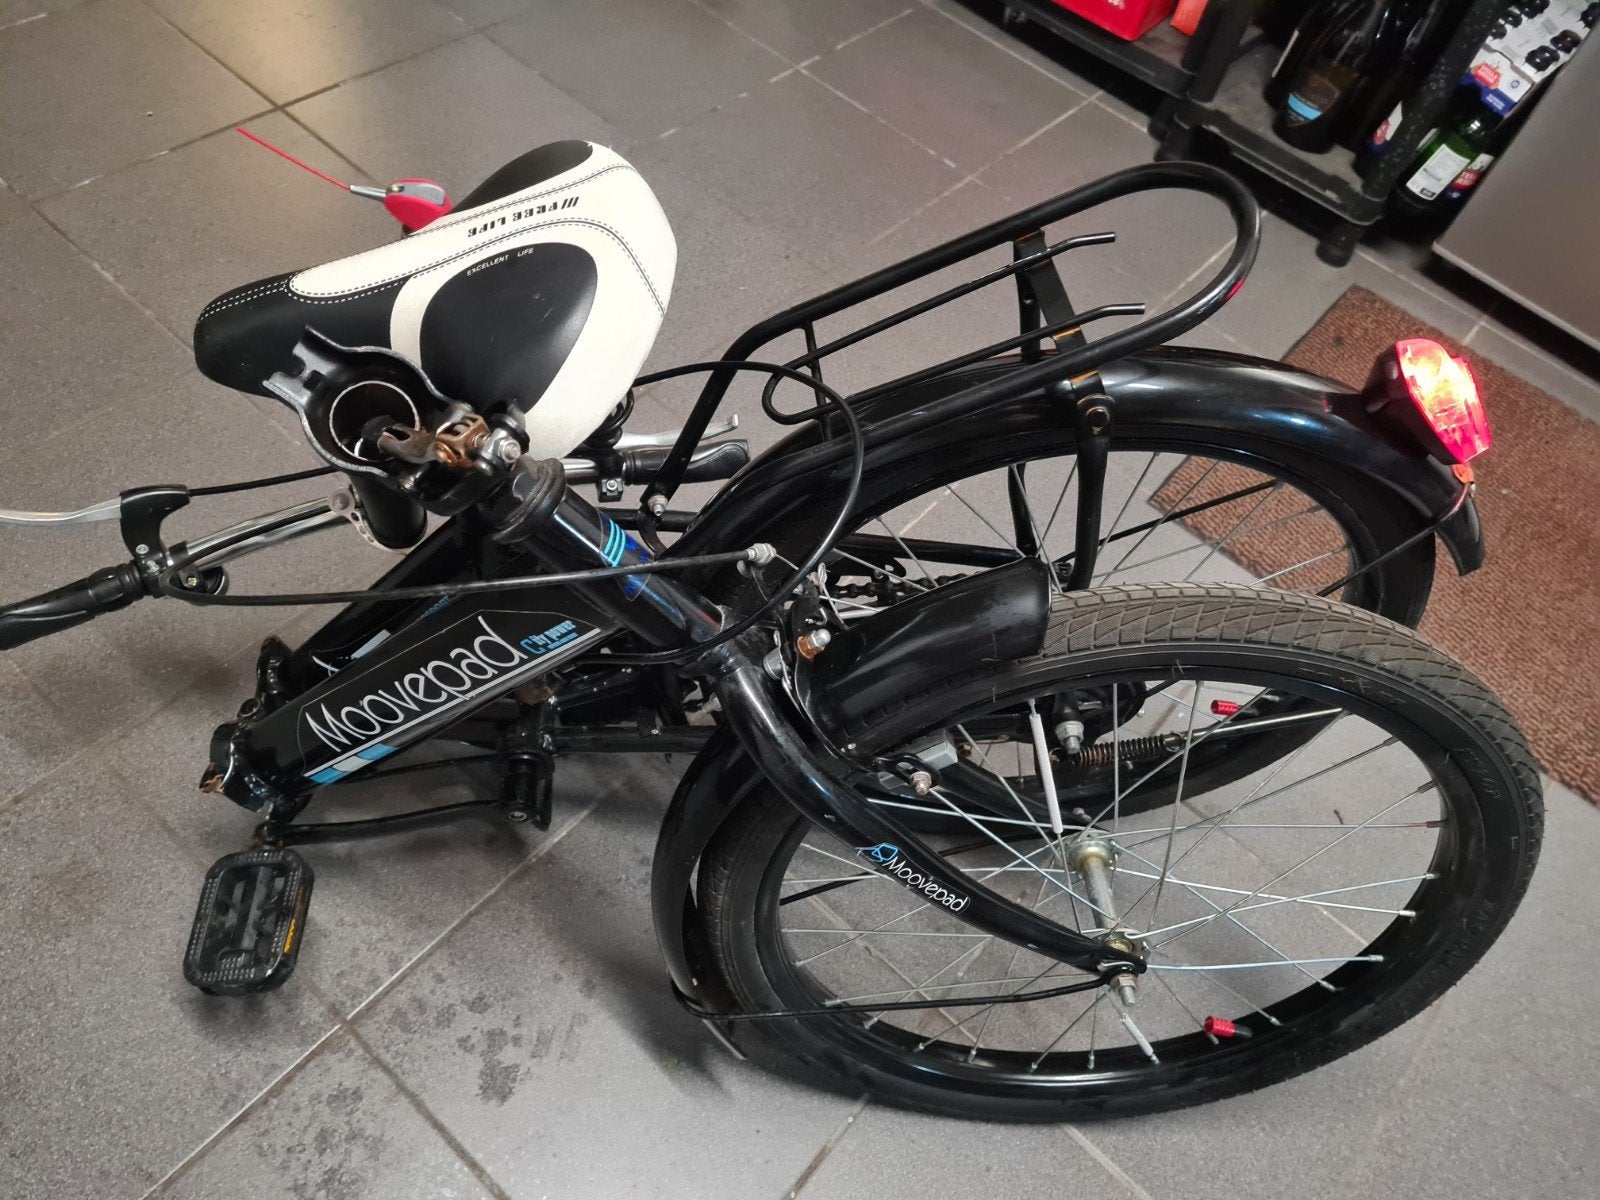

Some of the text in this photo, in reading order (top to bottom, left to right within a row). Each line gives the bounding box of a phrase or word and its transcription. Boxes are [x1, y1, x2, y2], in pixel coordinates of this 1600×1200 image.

[467, 201, 558, 237] FREE LIFE
[466, 247, 534, 276] EXCELLENT LIFE
[305, 615, 528, 753] Moovepad
[881, 856, 969, 911] Moovepad
